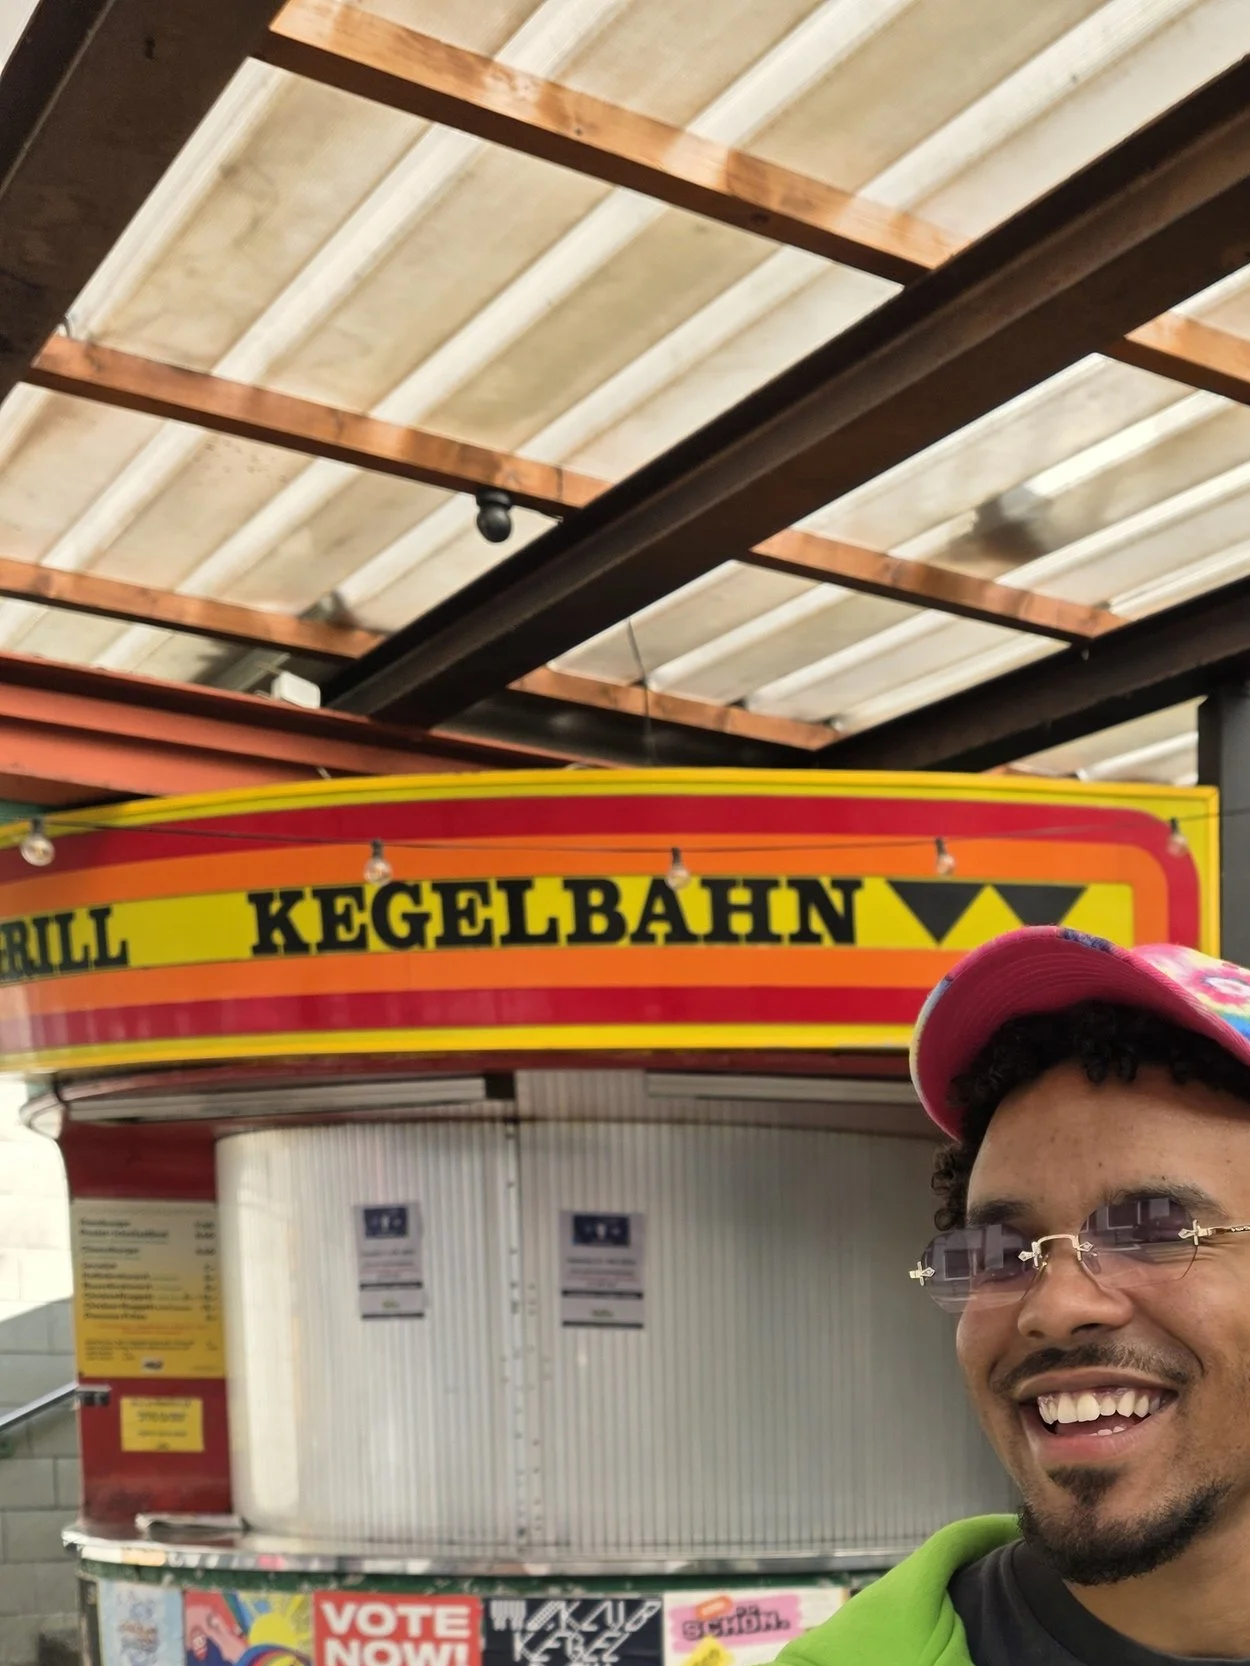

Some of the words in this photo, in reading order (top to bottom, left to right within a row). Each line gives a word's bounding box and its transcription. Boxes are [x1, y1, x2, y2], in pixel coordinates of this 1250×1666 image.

[0, 906, 130, 982] RILL
[247, 877, 865, 957] KEGELBAHN
[320, 1601, 472, 1639] VOTE
